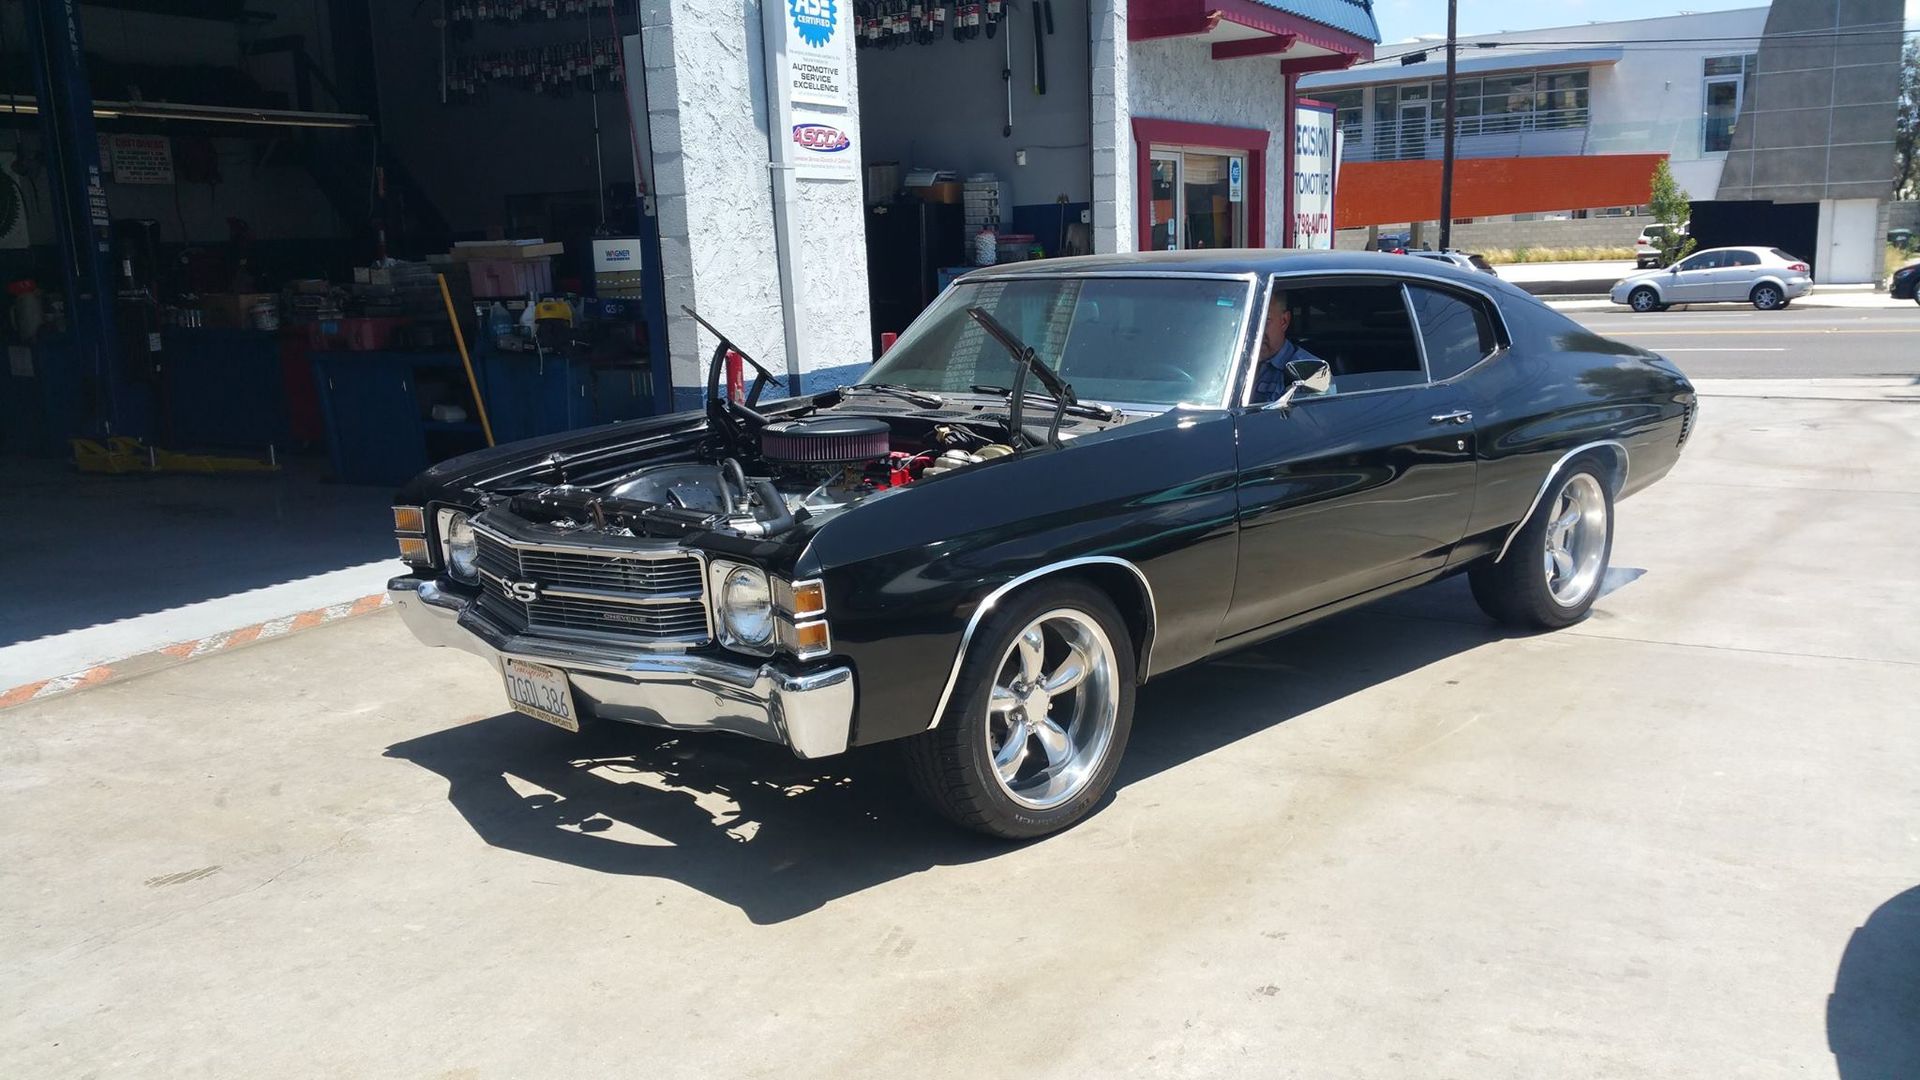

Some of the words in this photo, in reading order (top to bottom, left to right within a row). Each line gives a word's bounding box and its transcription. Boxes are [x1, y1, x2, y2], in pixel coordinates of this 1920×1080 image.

[798, 15, 830, 27] CERTIFIED
[792, 63, 839, 75] AUTOMOTIVE
[800, 72, 832, 84] SERVICE
[793, 81, 839, 92] EXCELLENCE
[793, 126, 847, 149] ASCCA
[605, 249, 630, 257] WAGNER
[501, 575, 537, 602] SS
[603, 613, 647, 624] CHEVELLE
